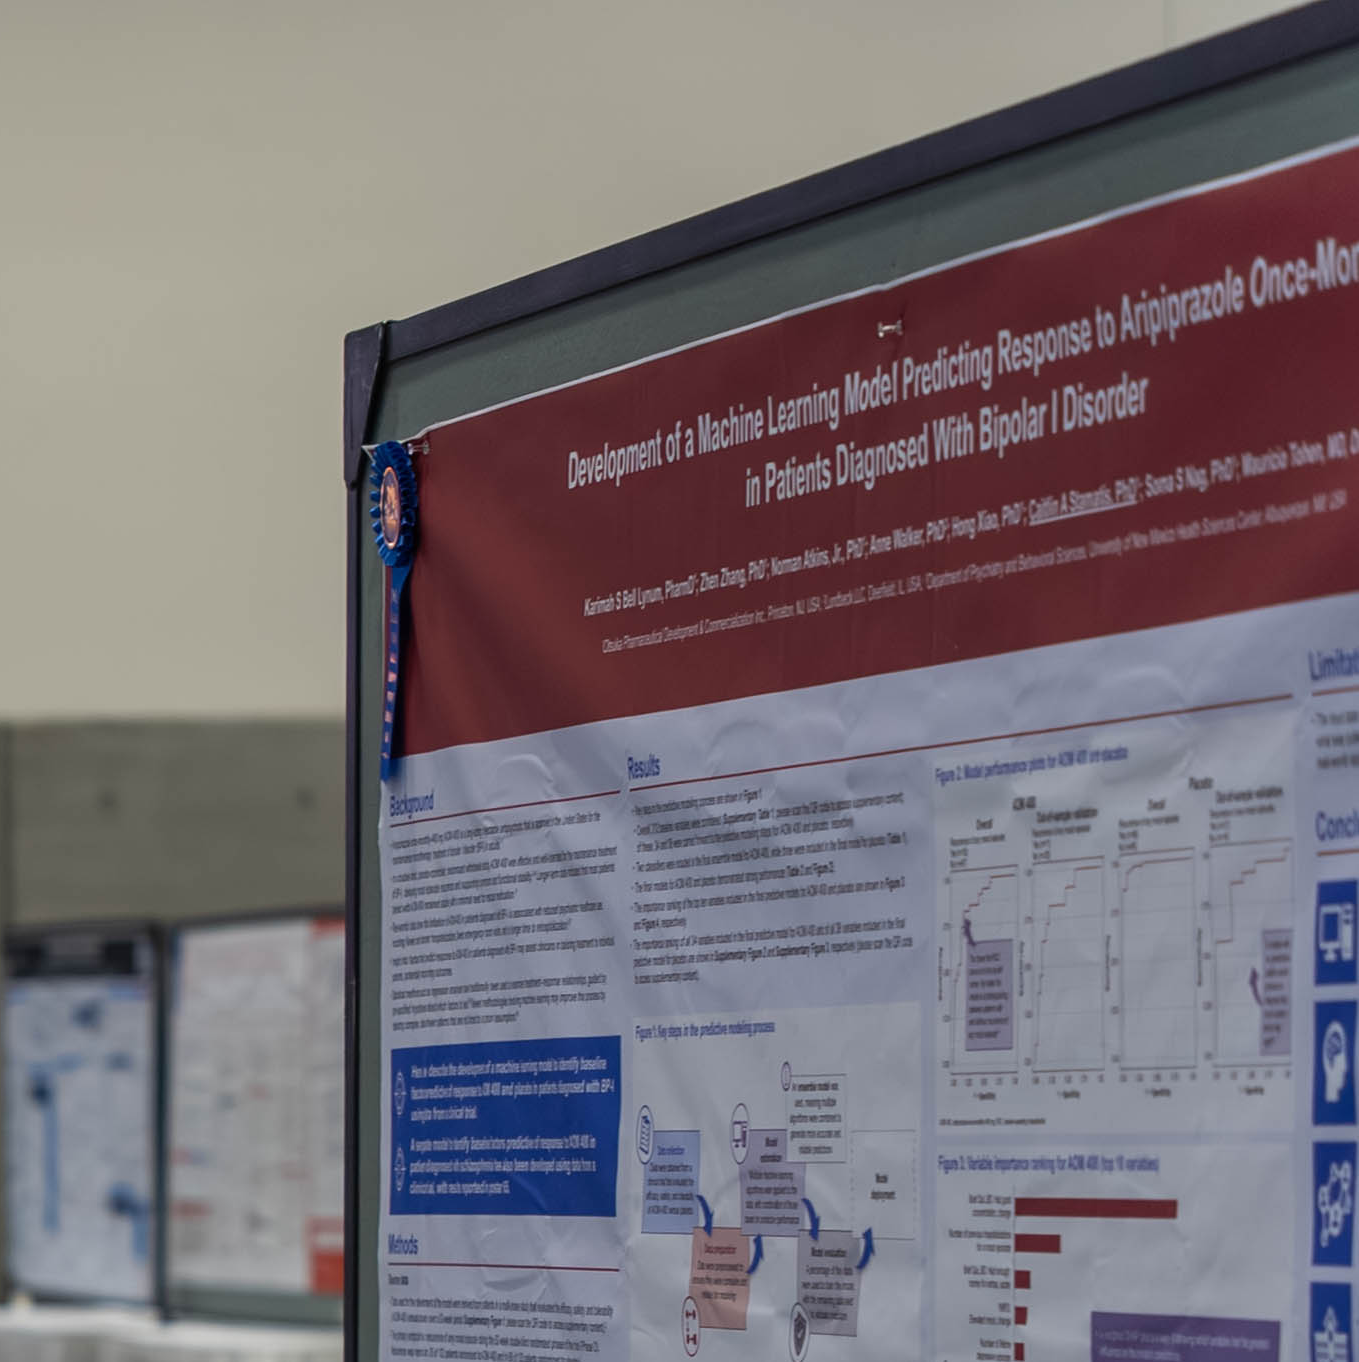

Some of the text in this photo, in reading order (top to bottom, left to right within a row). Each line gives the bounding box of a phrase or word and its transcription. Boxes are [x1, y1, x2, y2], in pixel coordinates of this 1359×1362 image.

[568, 429, 663, 489] Development
[665, 421, 681, 463] of
[684, 427, 695, 458] a
[698, 404, 764, 454] Machine
[767, 383, 840, 430] Learning
[844, 360, 898, 415] Model
[902, 340, 993, 400] Predicting
[997, 319, 1093, 377] Response
[1096, 306, 1116, 347] to
[1120, 265, 1245, 345] Aripiprazole
[745, 371, 1149, 507] in Patients Diagnosed With Bipolar I Disorder
[627, 754, 660, 780] Results
[390, 792, 434, 820] Background
[388, 1233, 418, 1254] Methods
